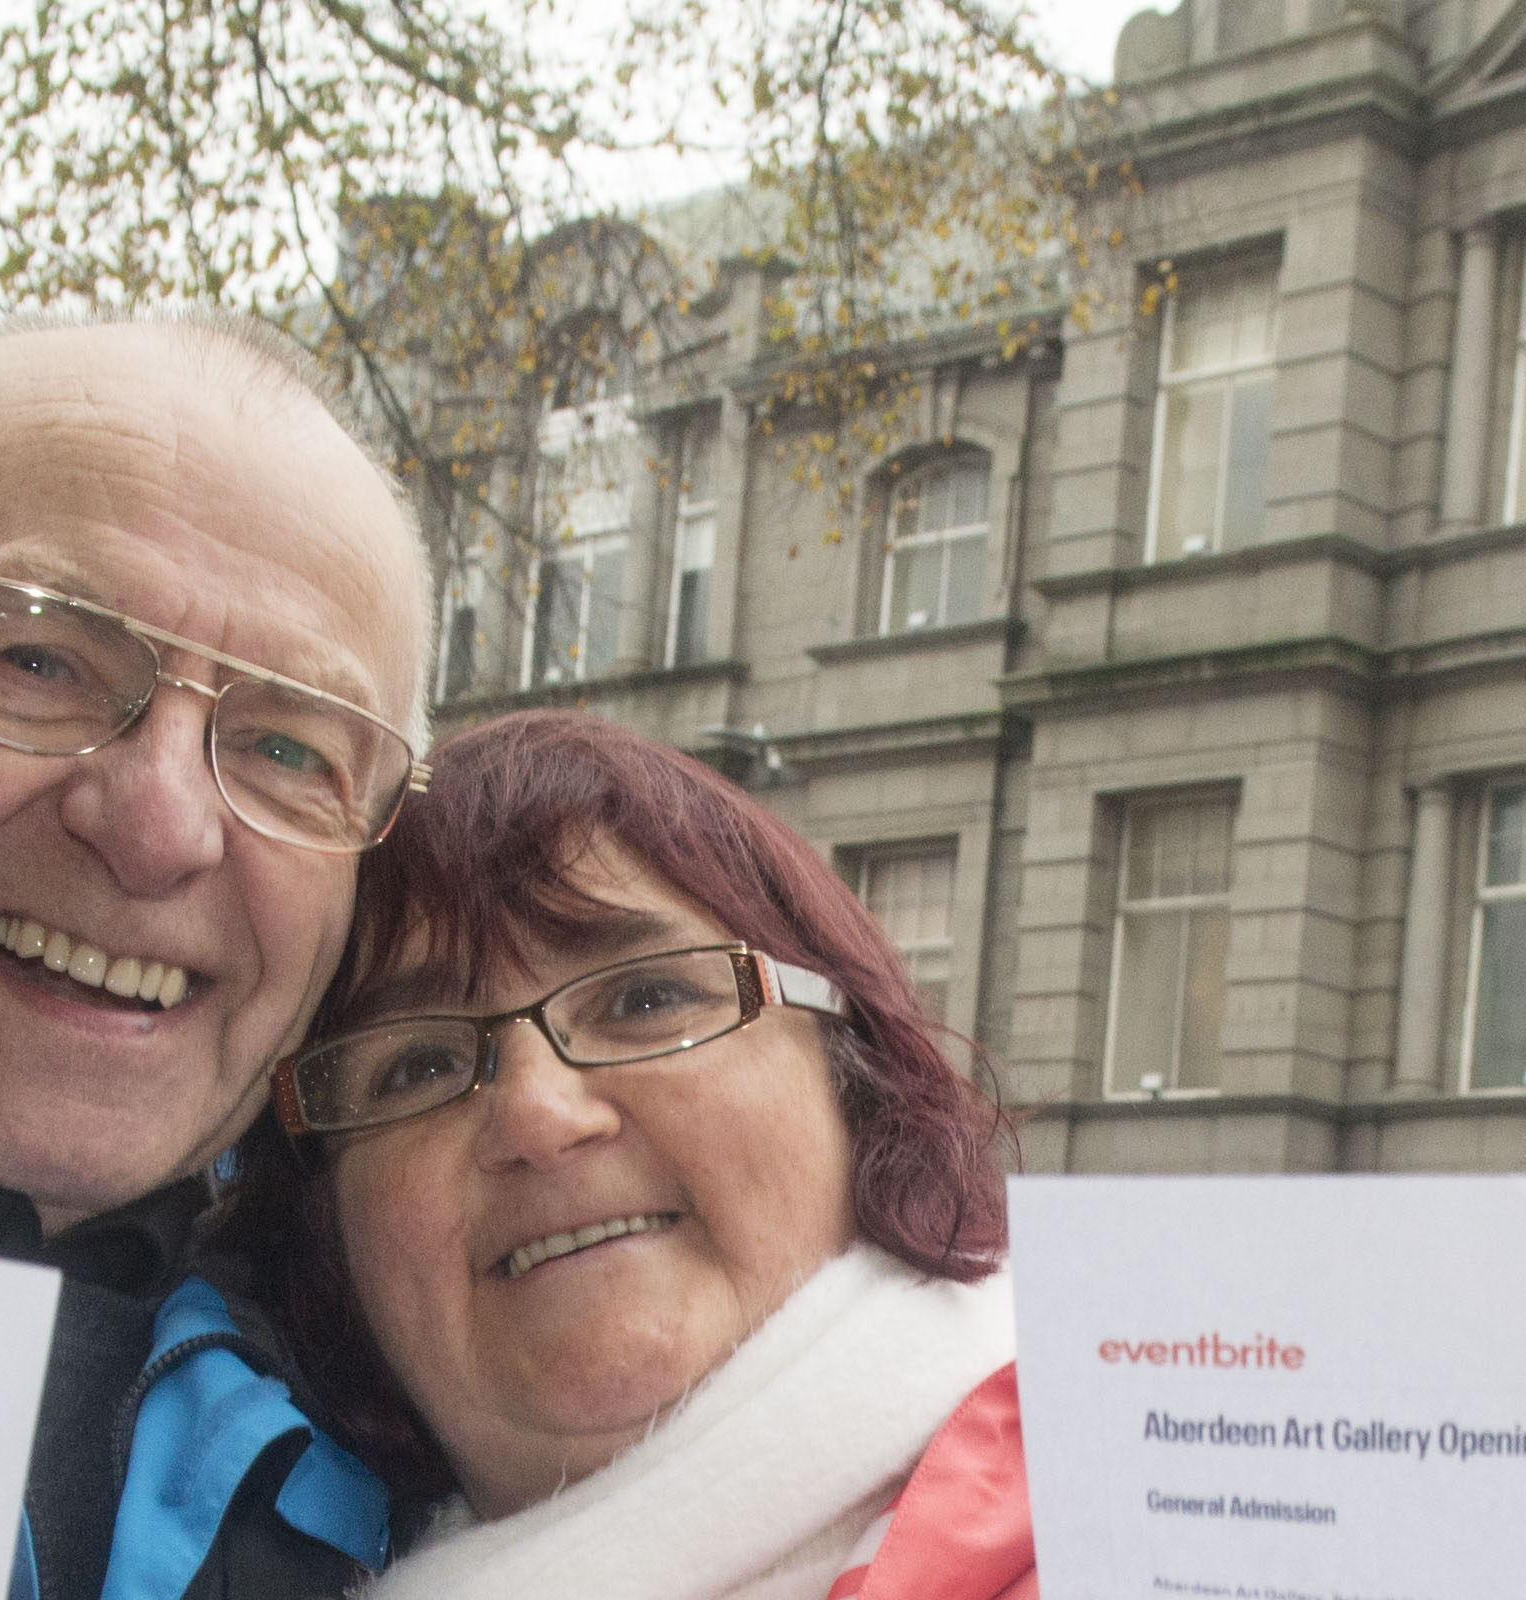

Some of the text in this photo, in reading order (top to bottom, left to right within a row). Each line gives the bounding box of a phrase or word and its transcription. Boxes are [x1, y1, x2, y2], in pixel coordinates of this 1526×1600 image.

[1098, 1332, 1305, 1371] eventbrite
[1144, 1412, 1276, 1446] Aberdeen
[1283, 1417, 1325, 1449] Art
[1331, 1420, 1430, 1457] Gallery
[1146, 1491, 1336, 1524] General Admission
[1152, 1576, 1231, 1597] Aberdeen
[1235, 1584, 1259, 1600] Art
